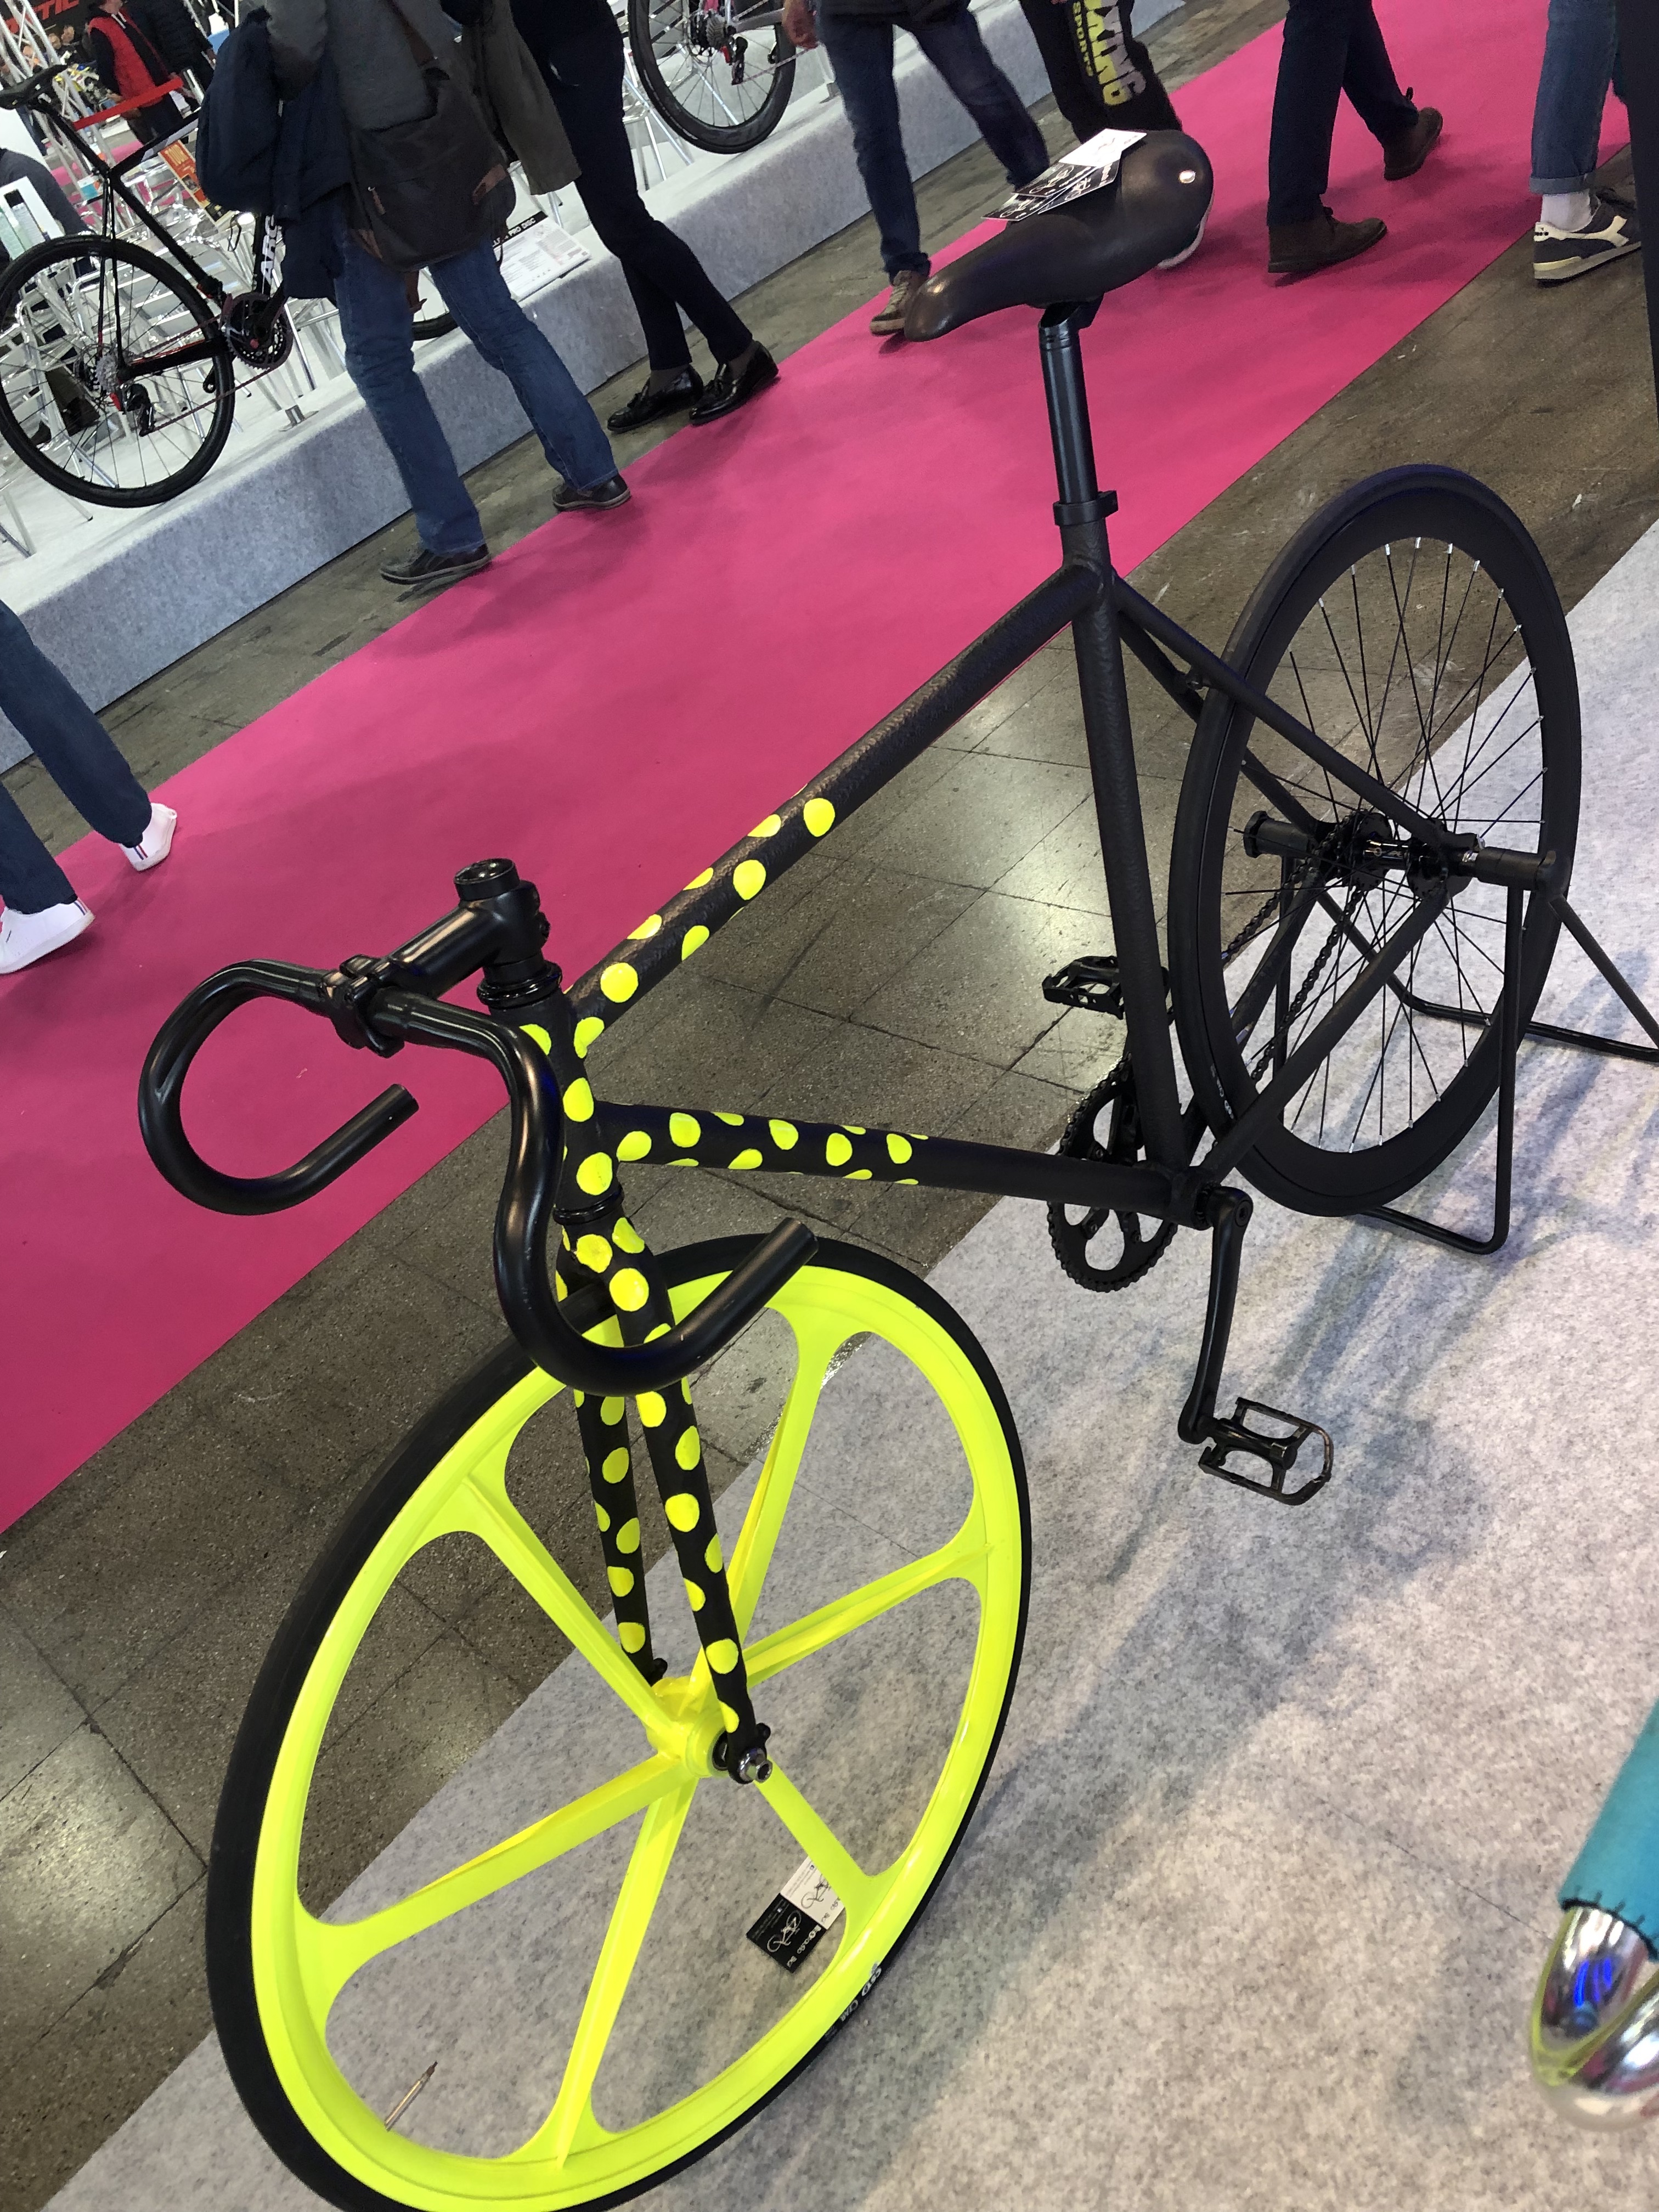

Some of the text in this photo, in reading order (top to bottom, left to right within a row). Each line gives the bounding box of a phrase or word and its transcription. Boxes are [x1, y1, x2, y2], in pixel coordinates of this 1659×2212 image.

[1084, 0, 1147, 105] XING
[508, 217, 536, 236] PRO DISC
